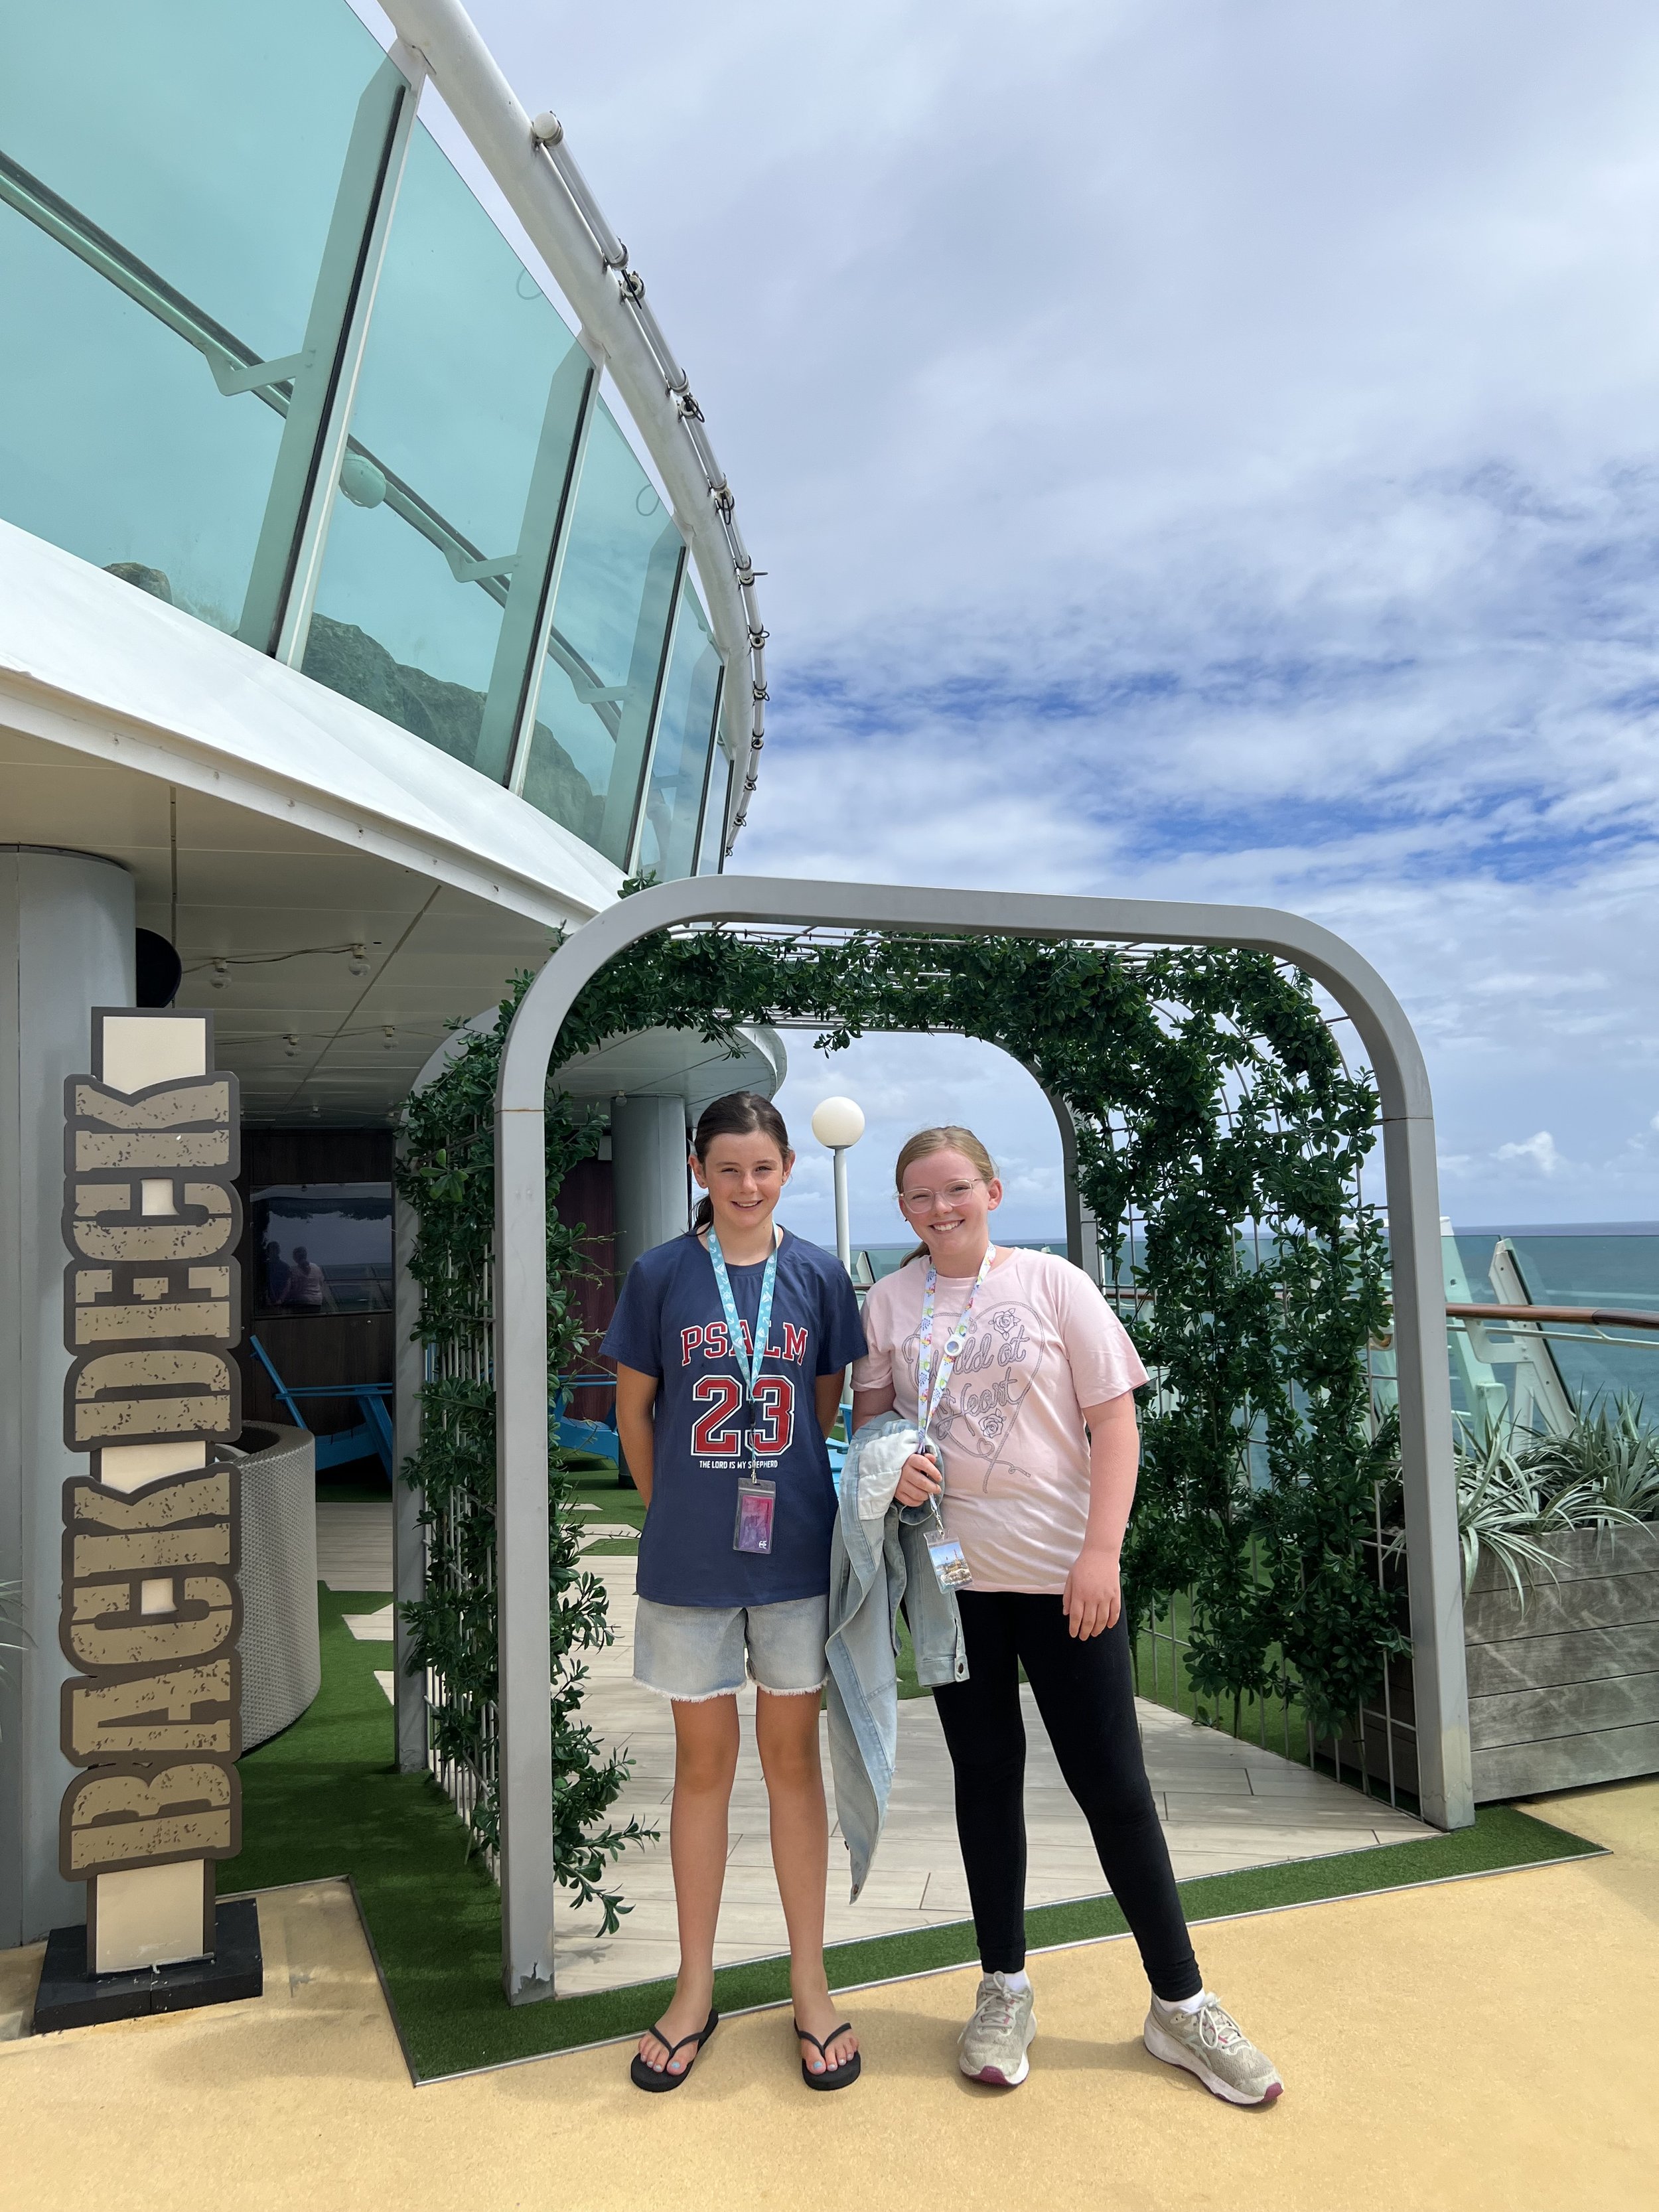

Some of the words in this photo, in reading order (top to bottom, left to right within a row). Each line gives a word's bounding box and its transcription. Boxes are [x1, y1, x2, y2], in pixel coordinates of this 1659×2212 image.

[72, 1078, 234, 1443] DECK
[997, 1325, 1030, 1367] at
[691, 1374, 795, 1457] 23
[699, 1460, 711, 1469] THE
[711, 1461, 728, 1469] LORD
[748, 1459, 778, 1469] SEPHERD
[68, 1471, 234, 1872] BACK
